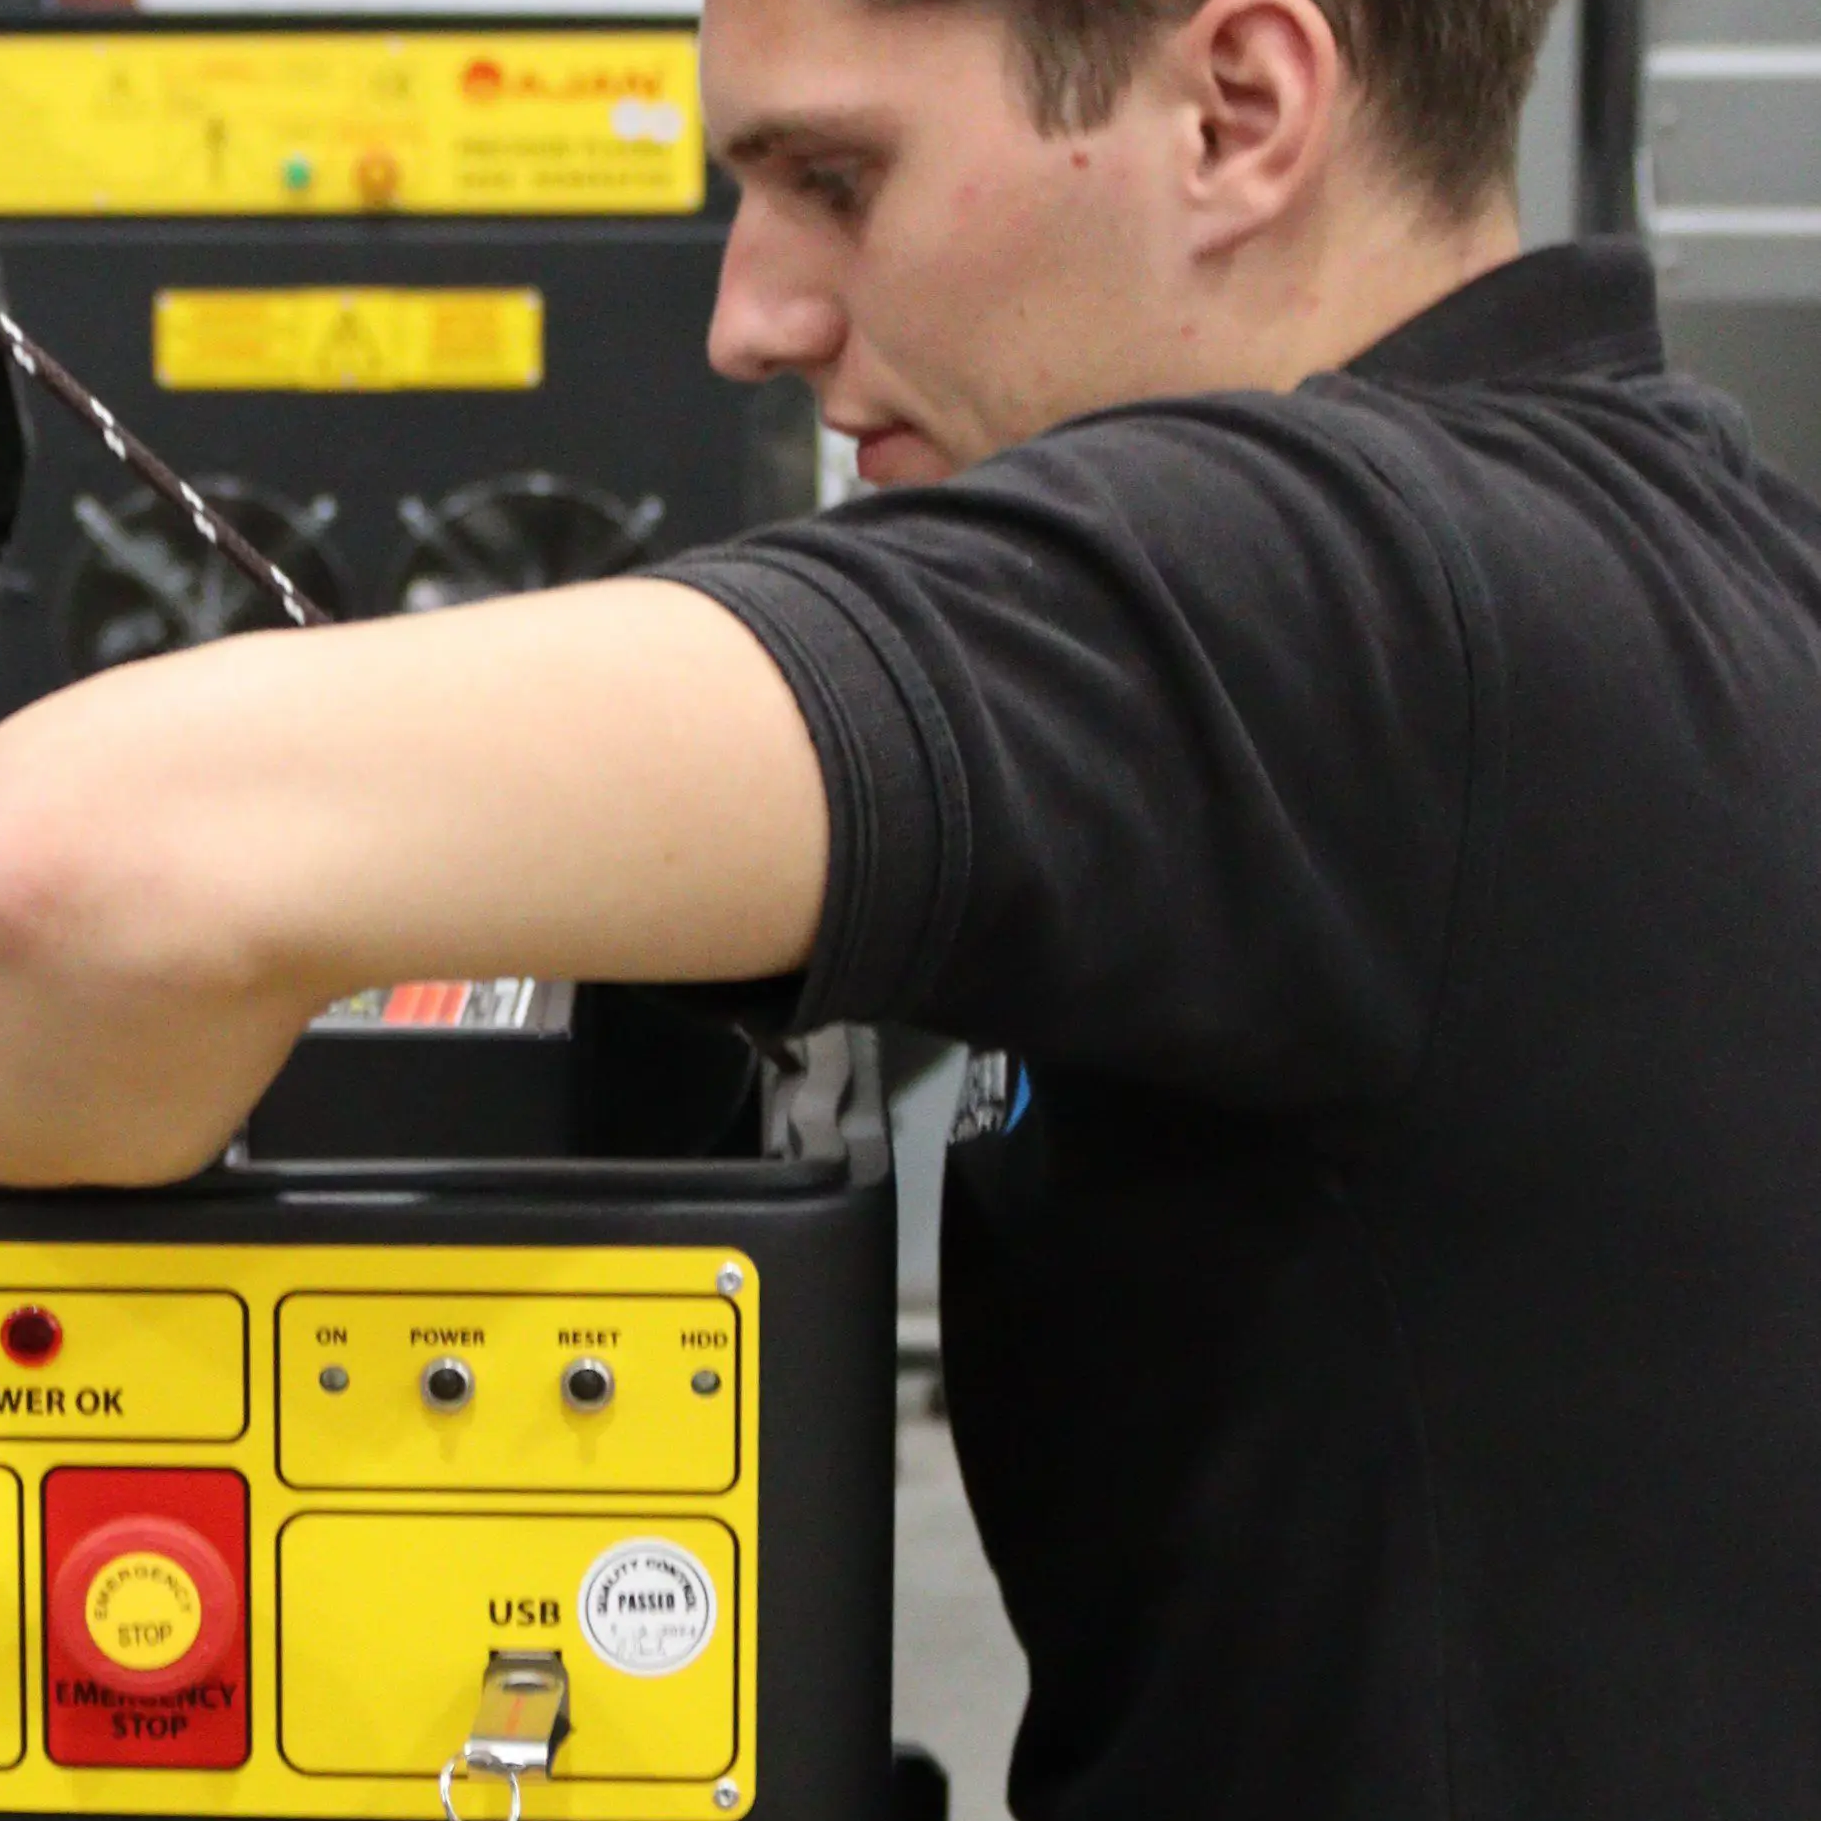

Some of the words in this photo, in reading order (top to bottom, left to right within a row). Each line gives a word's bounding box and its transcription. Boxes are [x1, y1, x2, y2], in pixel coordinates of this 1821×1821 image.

[316, 1328, 347, 1344] ON
[410, 1329, 484, 1345] POWER
[558, 1330, 618, 1346] RESET
[681, 1332, 728, 1348] HDD
[76, 1389, 122, 1414] OK
[96, 1564, 191, 1620] EMERGENCY
[618, 1593, 676, 1613] PASSED
[489, 1600, 560, 1625] USB
[118, 1622, 172, 1647] STOP
[112, 1711, 188, 1738] STOP
